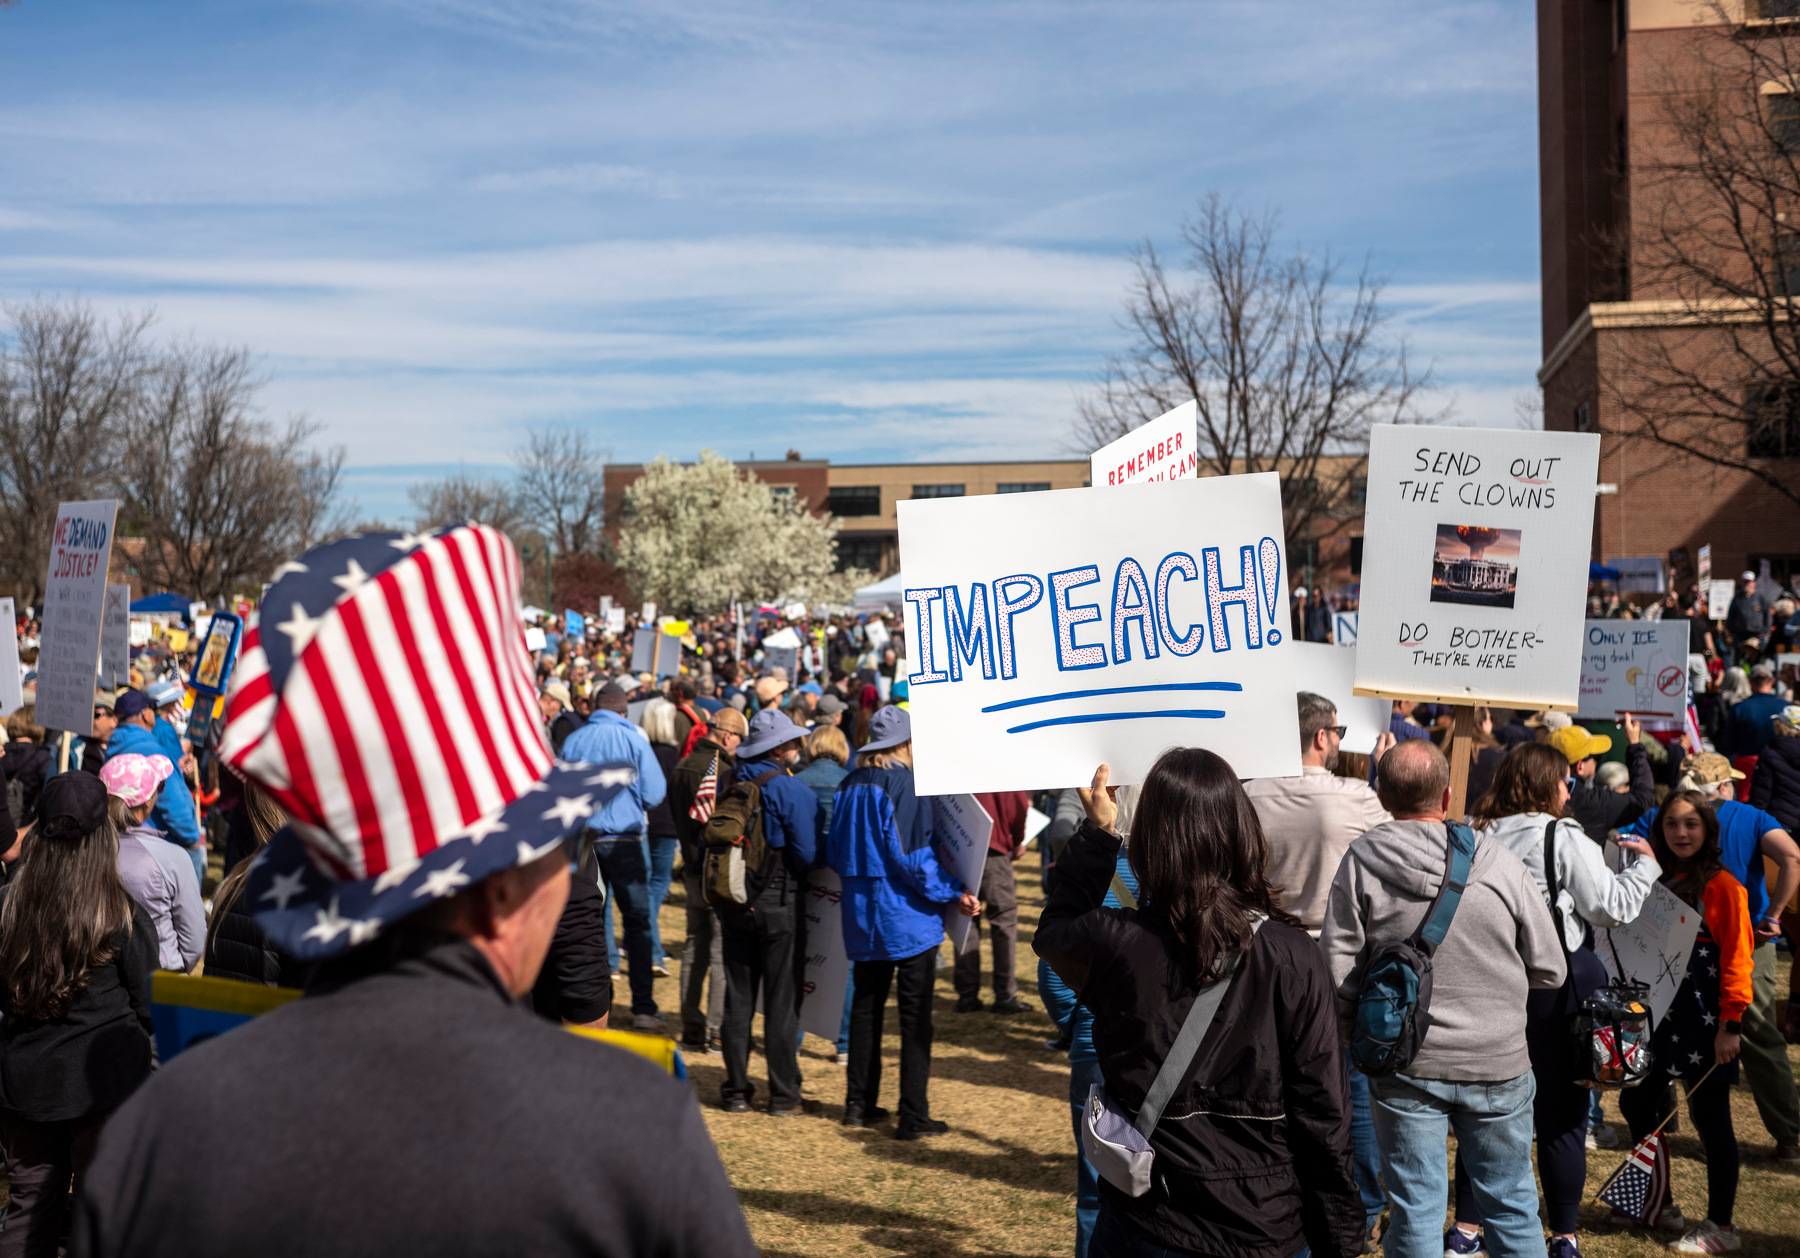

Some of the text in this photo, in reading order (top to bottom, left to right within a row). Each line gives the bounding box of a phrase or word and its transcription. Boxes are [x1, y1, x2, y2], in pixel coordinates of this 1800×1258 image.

[1108, 432, 1182, 486] REMEMBER
[1169, 451, 1196, 481] CAN
[1414, 448, 1561, 480] SEND OUT
[1399, 481, 1556, 509] THE CLOWNS
[54, 517, 106, 551] WE DEMAND
[54, 548, 98, 584] JUSTICE!
[905, 536, 1282, 686] IMPEACH!
[1399, 622, 1544, 650] DO BOTHER-
[1632, 630, 1658, 645] ICE
[1413, 650, 1517, 668] THEY'RE HERE
[1591, 653, 1606, 672] my
[948, 794, 964, 814] Our
[1643, 902, 1673, 933] aders
[1633, 933, 1648, 954] the
